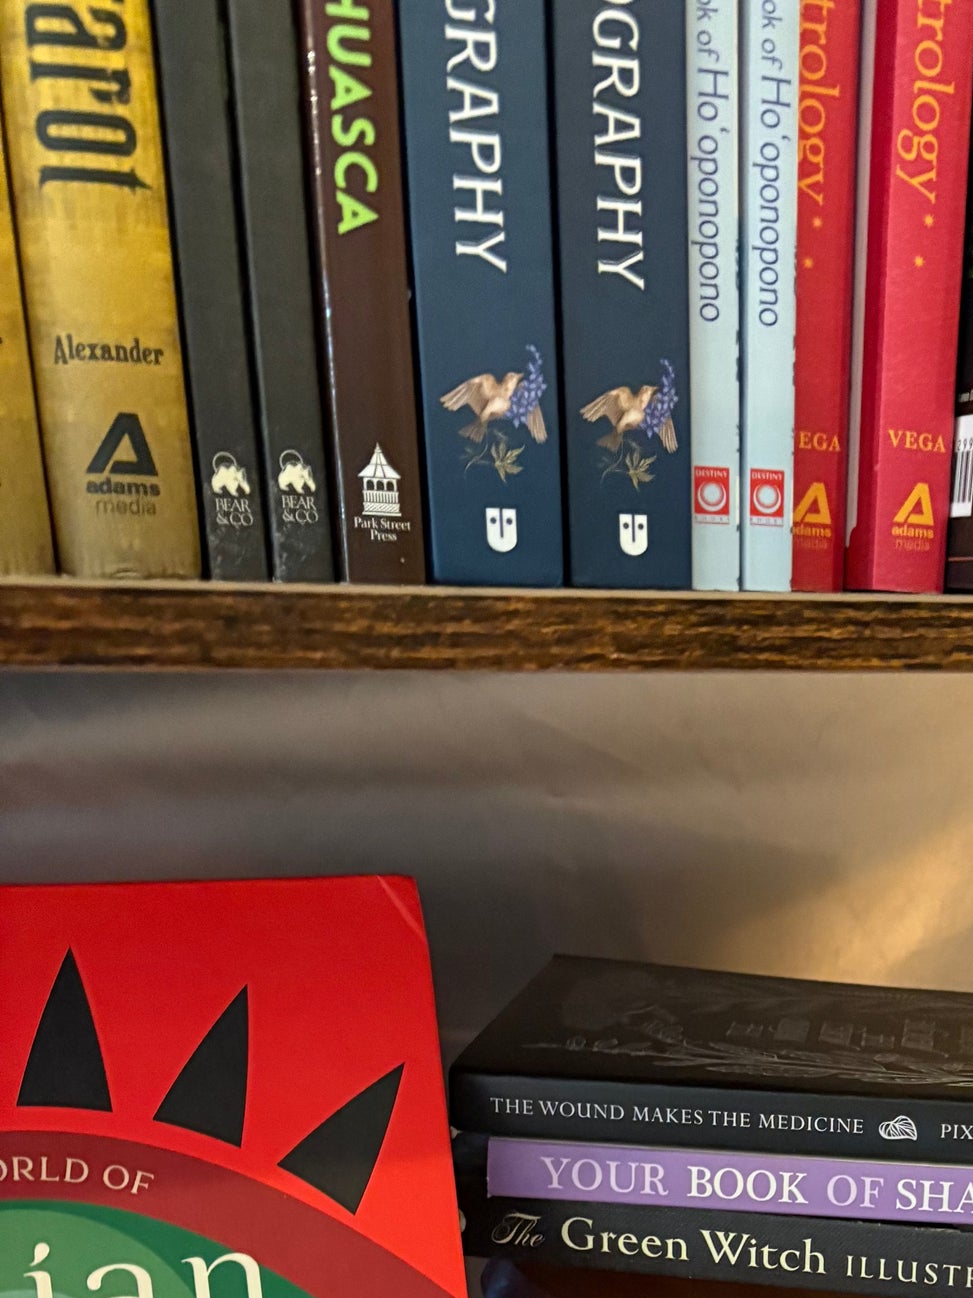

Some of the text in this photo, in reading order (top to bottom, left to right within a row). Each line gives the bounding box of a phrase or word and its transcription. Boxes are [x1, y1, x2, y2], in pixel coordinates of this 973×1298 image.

[697, 30, 720, 62] of
[761, 38, 783, 70] of
[26, 0, 152, 195] arot
[592, 0, 645, 291] GRAPHY
[54, 334, 164, 366] Alexander
[888, 429, 946, 453] VEGA
[86, 477, 161, 497] adams
[281, 495, 316, 510] BEAR
[95, 500, 156, 516] media
[215, 498, 250, 512] BEAR
[354, 516, 412, 532] Park Street
[370, 530, 397, 542] Press
[891, 525, 934, 539] adams
[490, 1097, 534, 1115] THE
[539, 1100, 625, 1120] WOUND
[632, 1105, 703, 1125] MAKES
[708, 1110, 751, 1128] THE
[758, 1113, 864, 1134] MEDICINE
[0, 1156, 155, 1195] RLD OF
[541, 1155, 669, 1197] YOUR
[687, 1165, 808, 1205] BOOK
[827, 1174, 885, 1209] OF
[490, 1212, 546, 1250] The
[560, 1216, 689, 1262] Green
[700, 1228, 826, 1276] Witch
